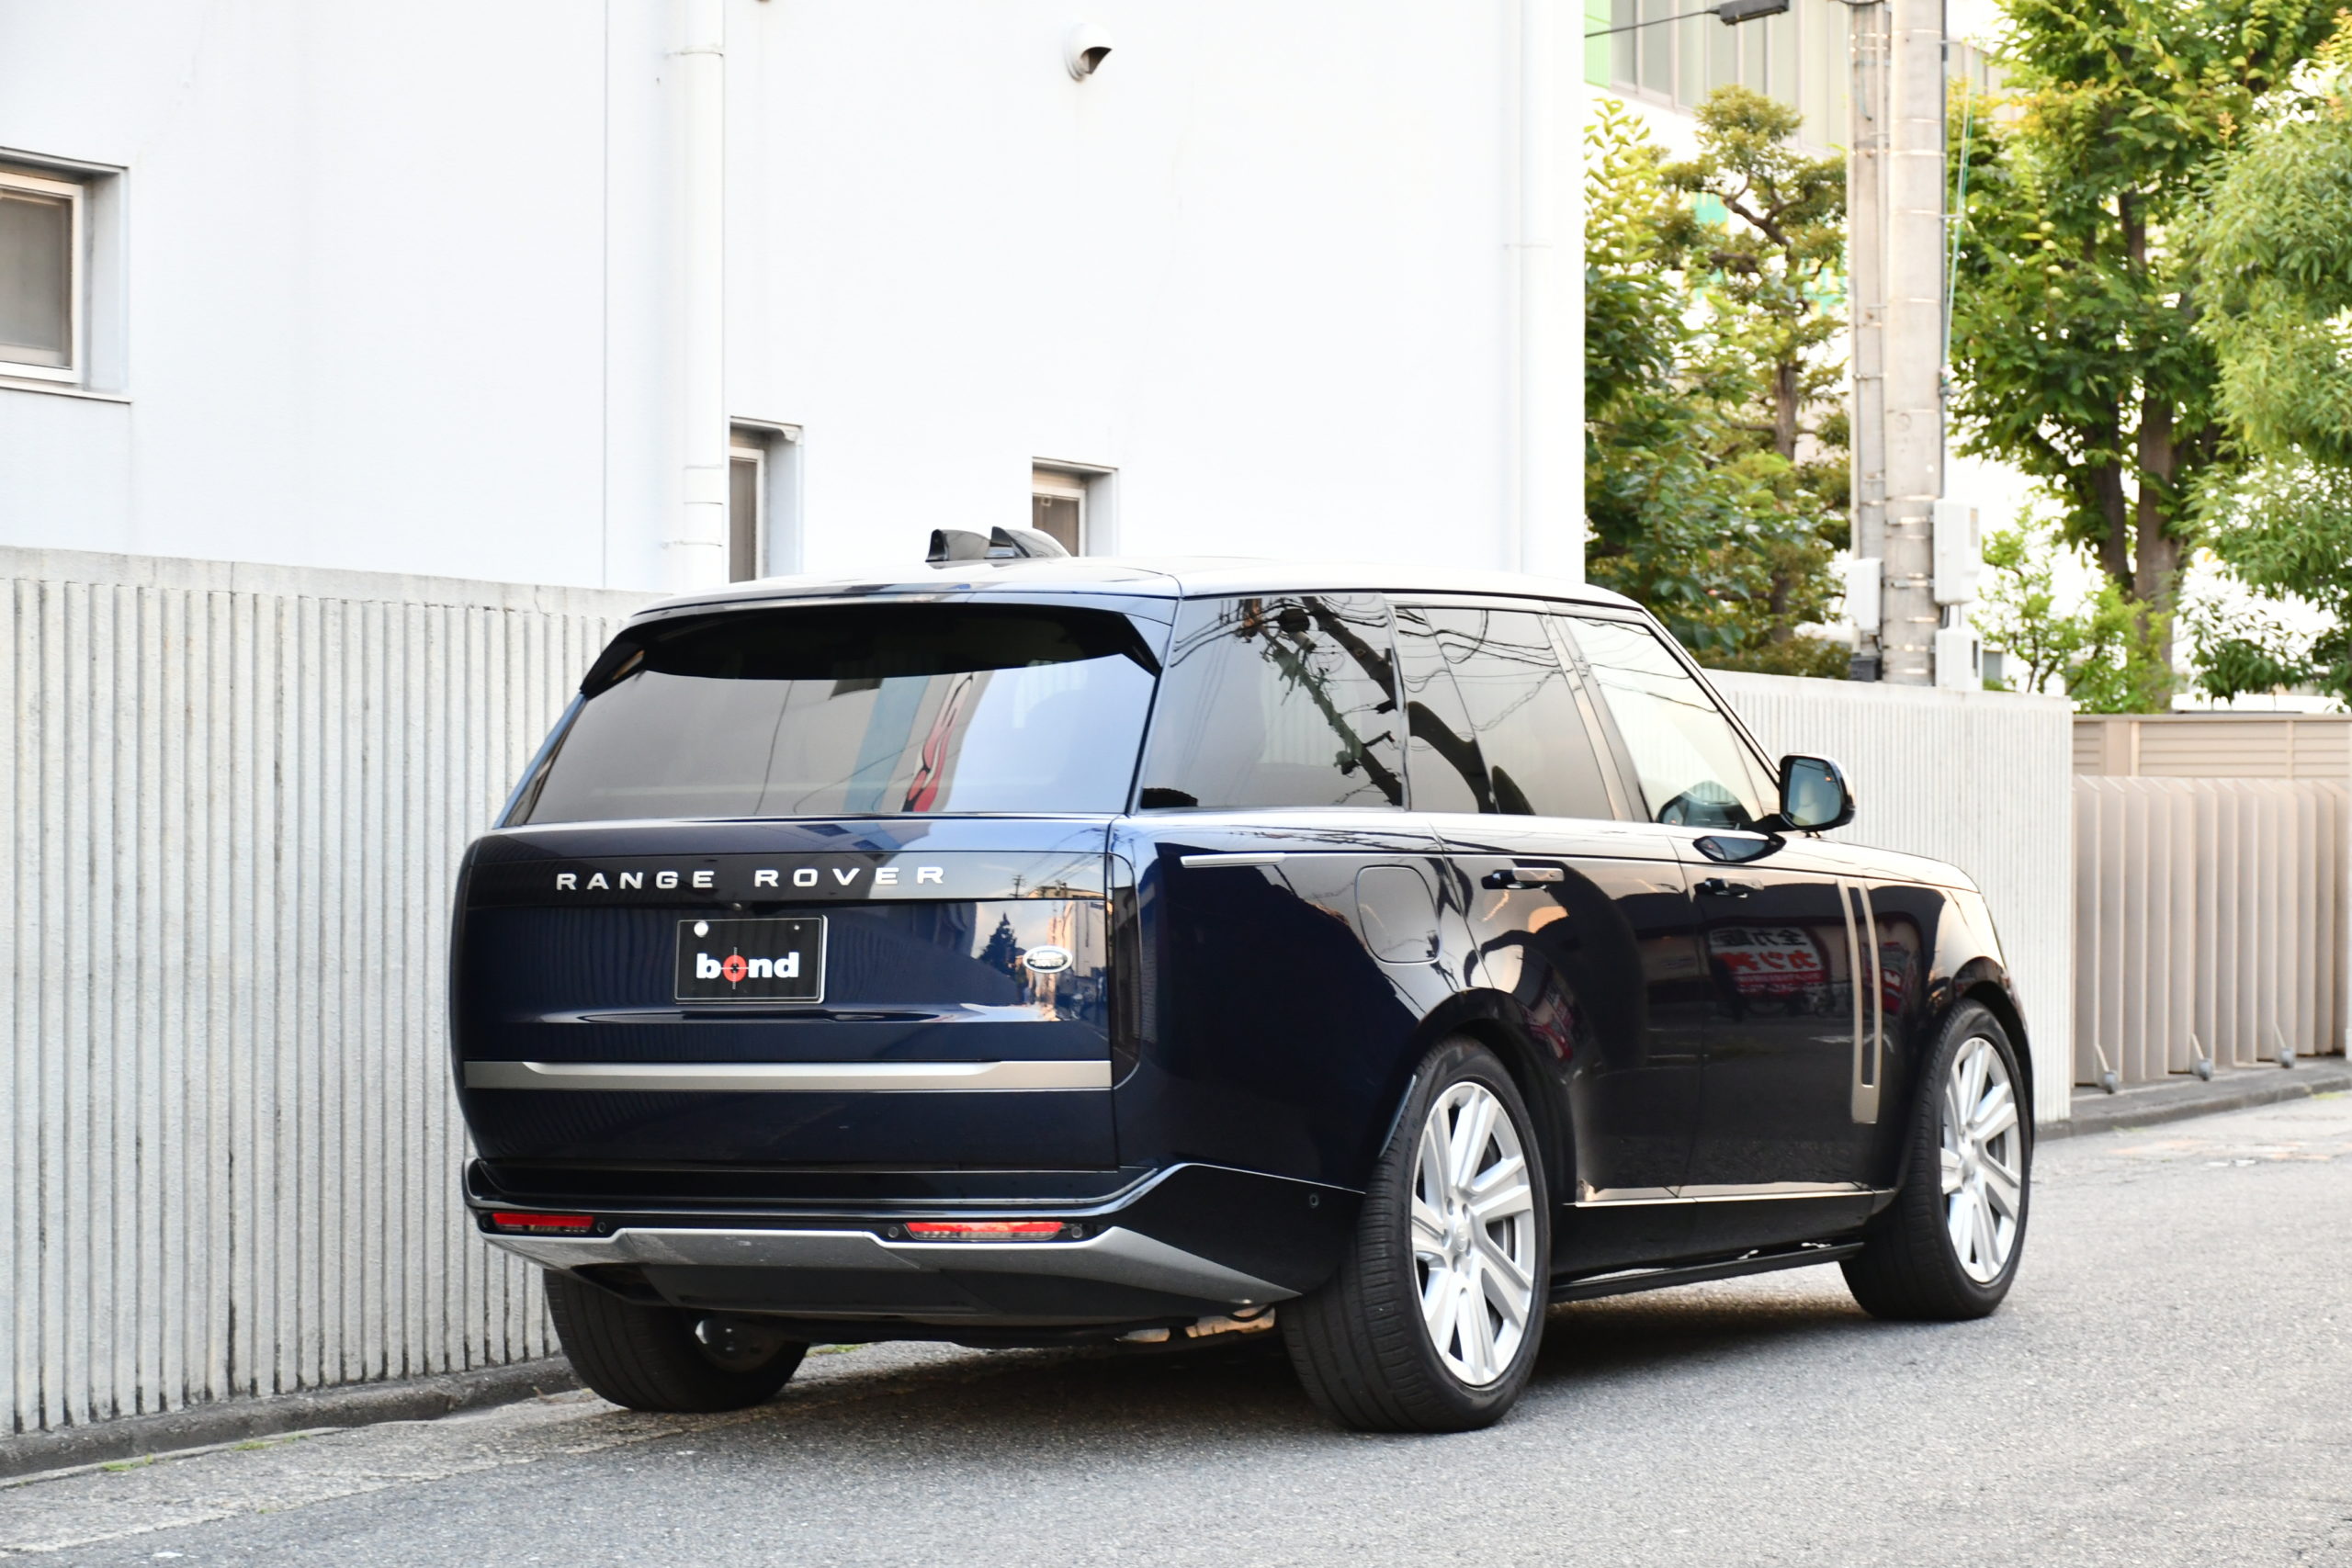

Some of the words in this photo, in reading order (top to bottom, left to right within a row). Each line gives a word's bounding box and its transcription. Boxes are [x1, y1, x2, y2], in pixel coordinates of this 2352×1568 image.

[556, 871, 715, 890] RANGE
[754, 866, 944, 887] ROVER
[695, 951, 800, 984] bond
